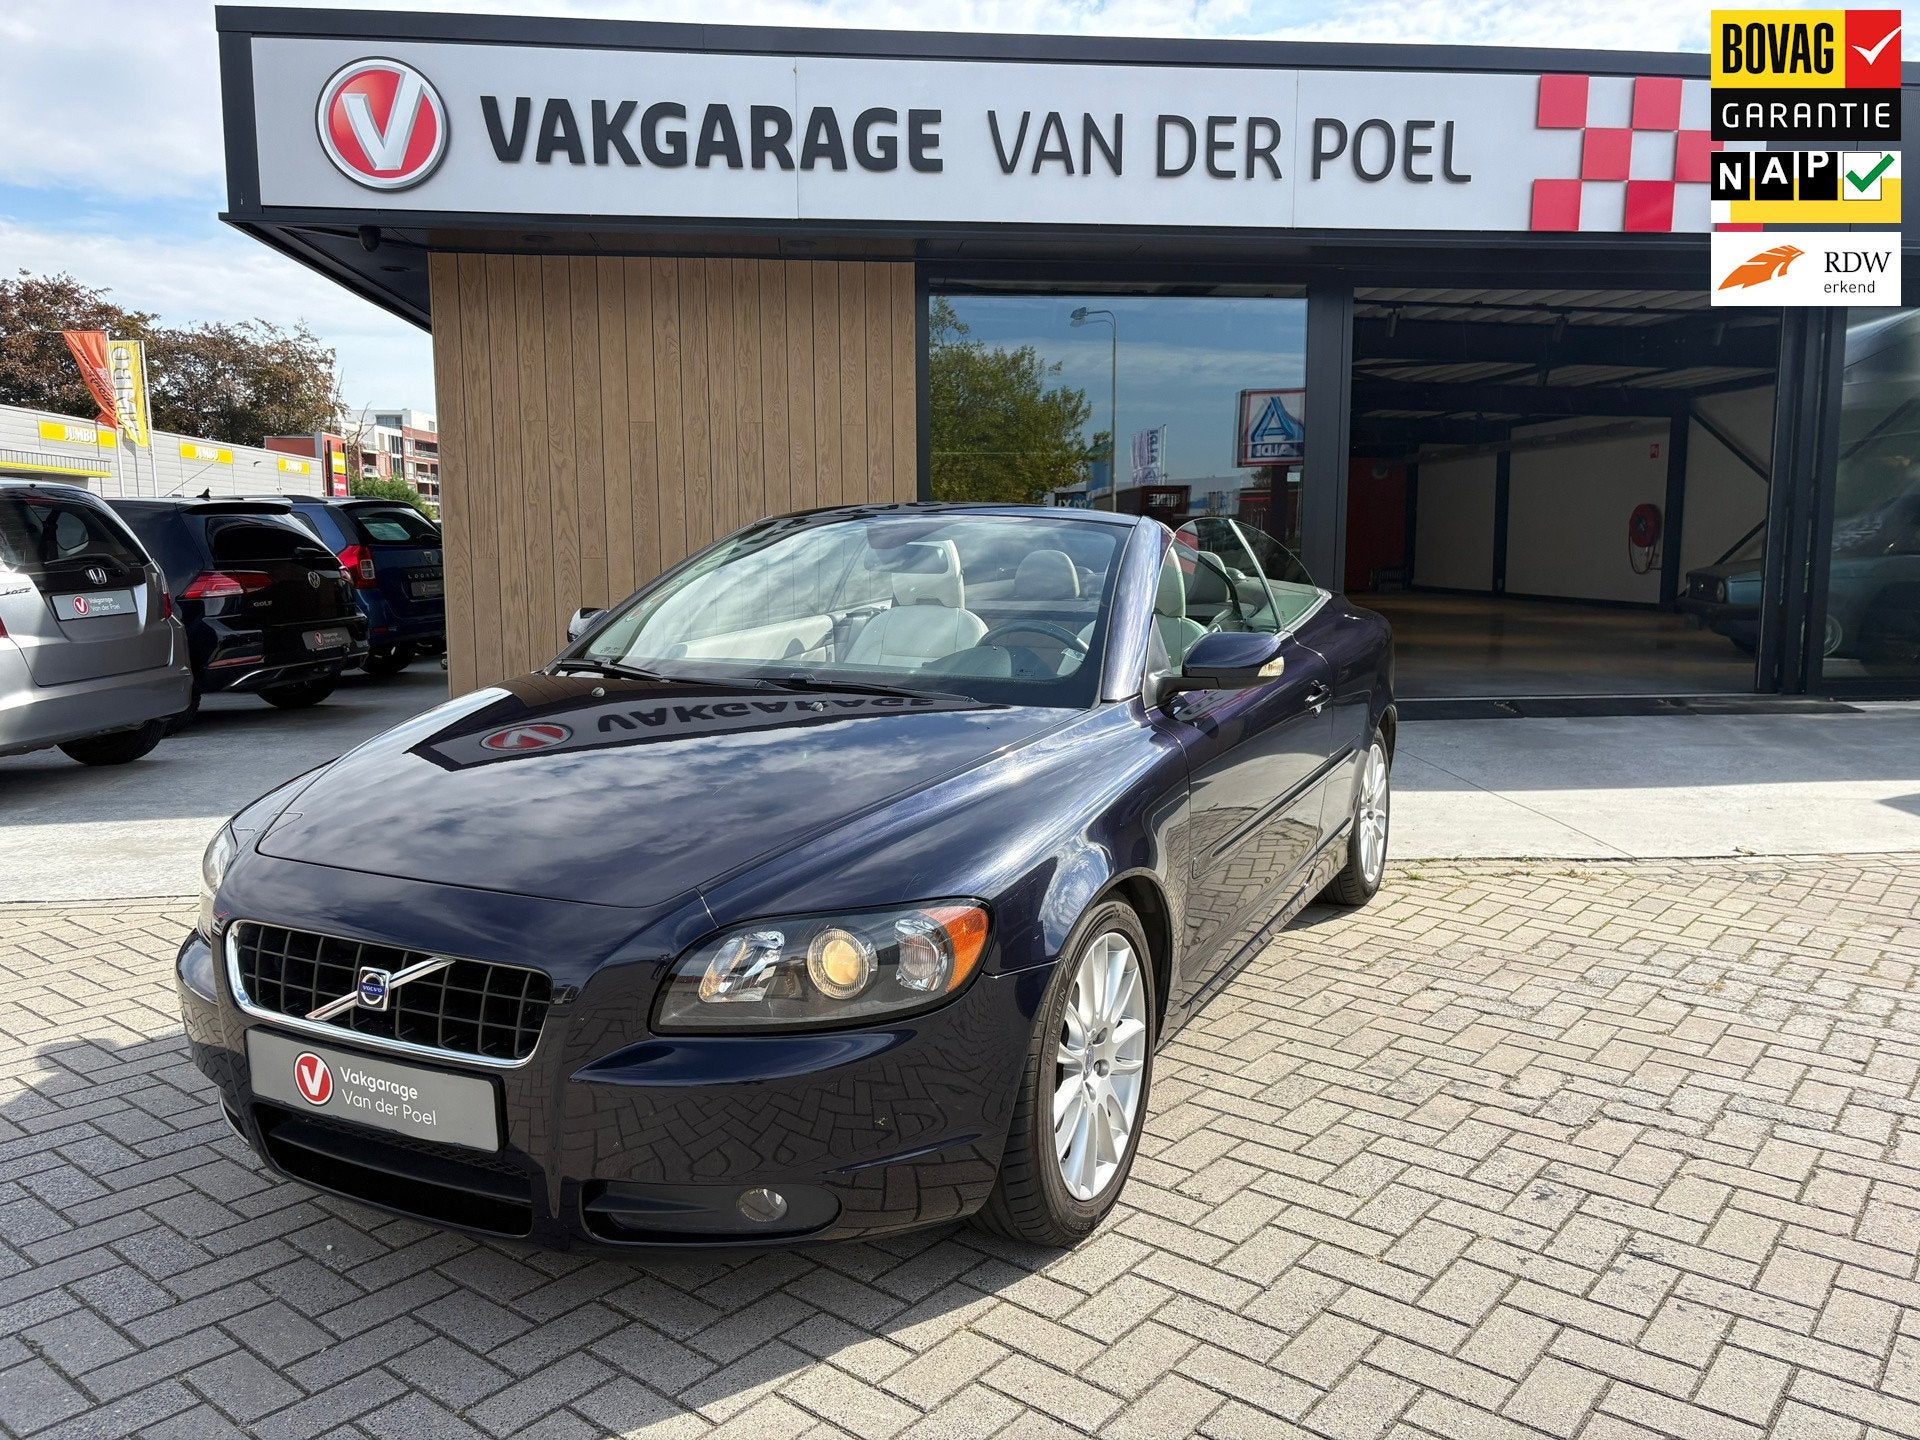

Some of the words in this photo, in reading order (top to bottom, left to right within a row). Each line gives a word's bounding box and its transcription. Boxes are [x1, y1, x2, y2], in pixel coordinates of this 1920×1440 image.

[480, 95, 943, 172] VAKGARAGE
[987, 110, 1123, 175] VAN
[1158, 114, 1282, 180] DER
[1312, 118, 1472, 183] POEL
[65, 426, 97, 443] JUMBO
[362, 984, 383, 993] VOLVO
[340, 1066, 418, 1101] Vakgarage
[342, 1088, 371, 1110] Van
[375, 1100, 399, 1117] der
[402, 1104, 437, 1126] Poel
